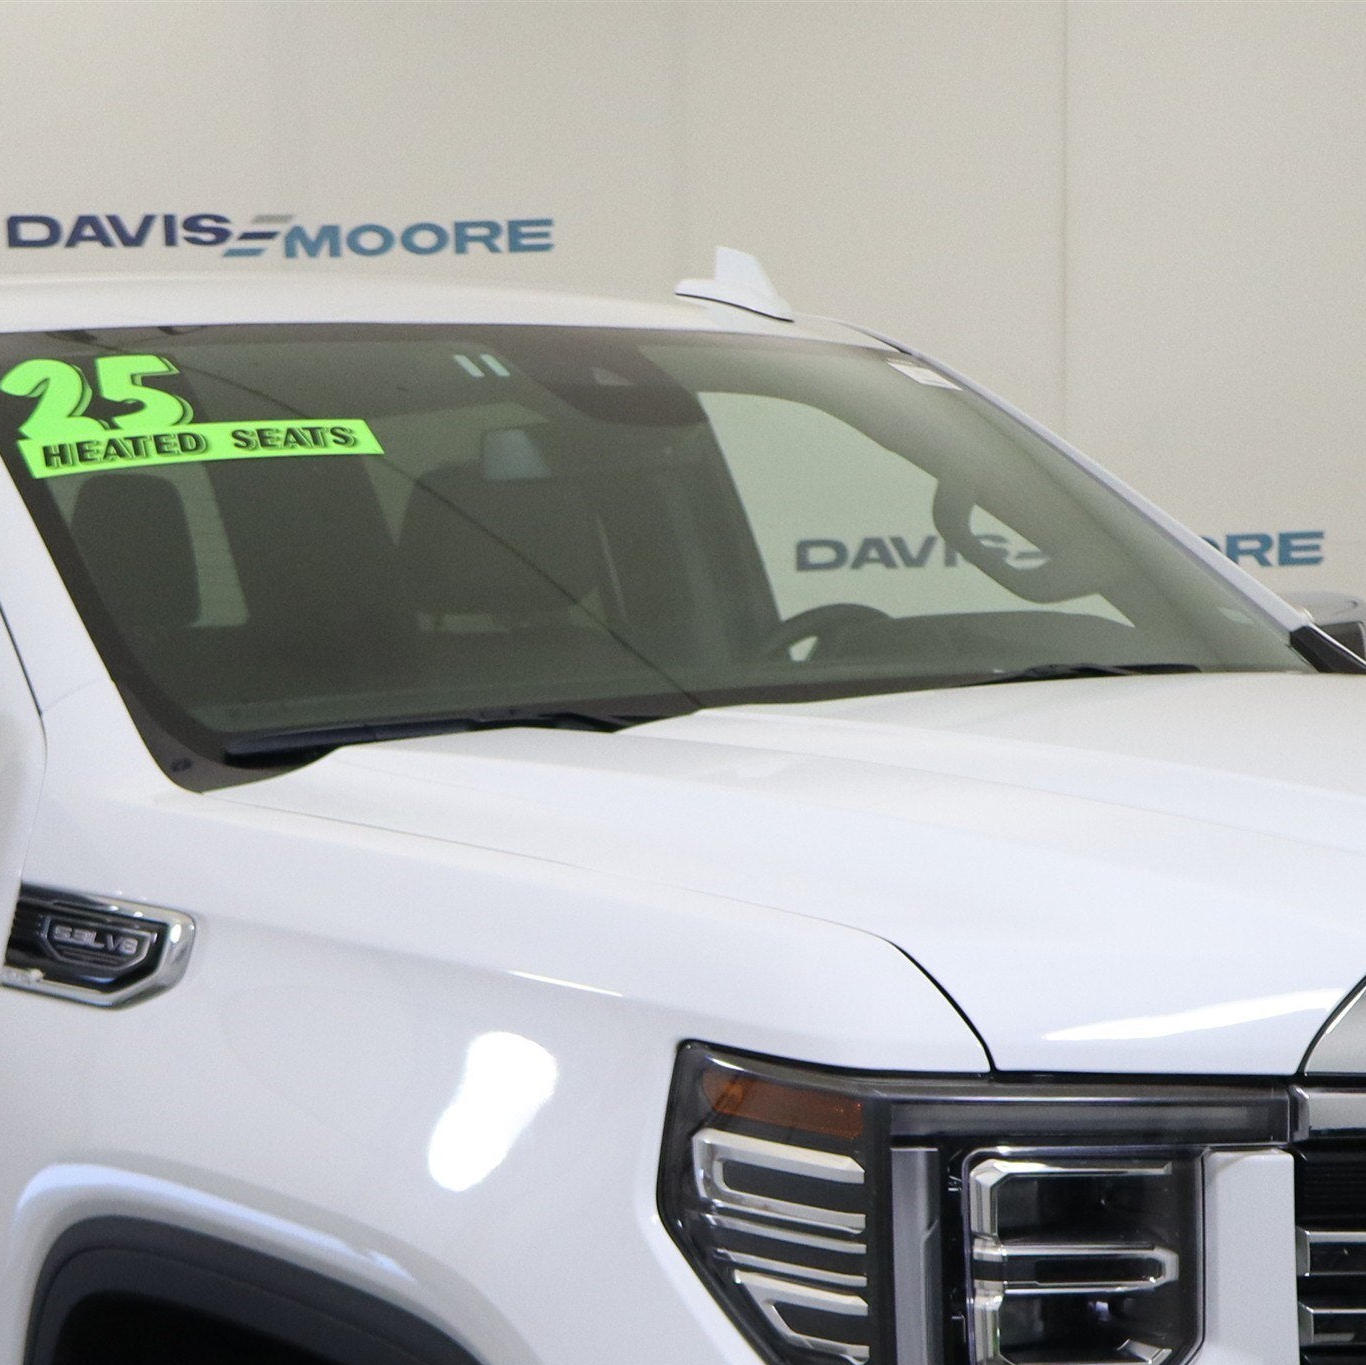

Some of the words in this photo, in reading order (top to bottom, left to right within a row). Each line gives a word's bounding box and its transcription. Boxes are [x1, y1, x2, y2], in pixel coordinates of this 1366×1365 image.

[6, 213, 233, 248] DAVIS
[282, 219, 555, 259] MOORE
[41, 432, 209, 469] HEATED
[231, 425, 358, 451] SEATS
[1200, 530, 1325, 567] RE
